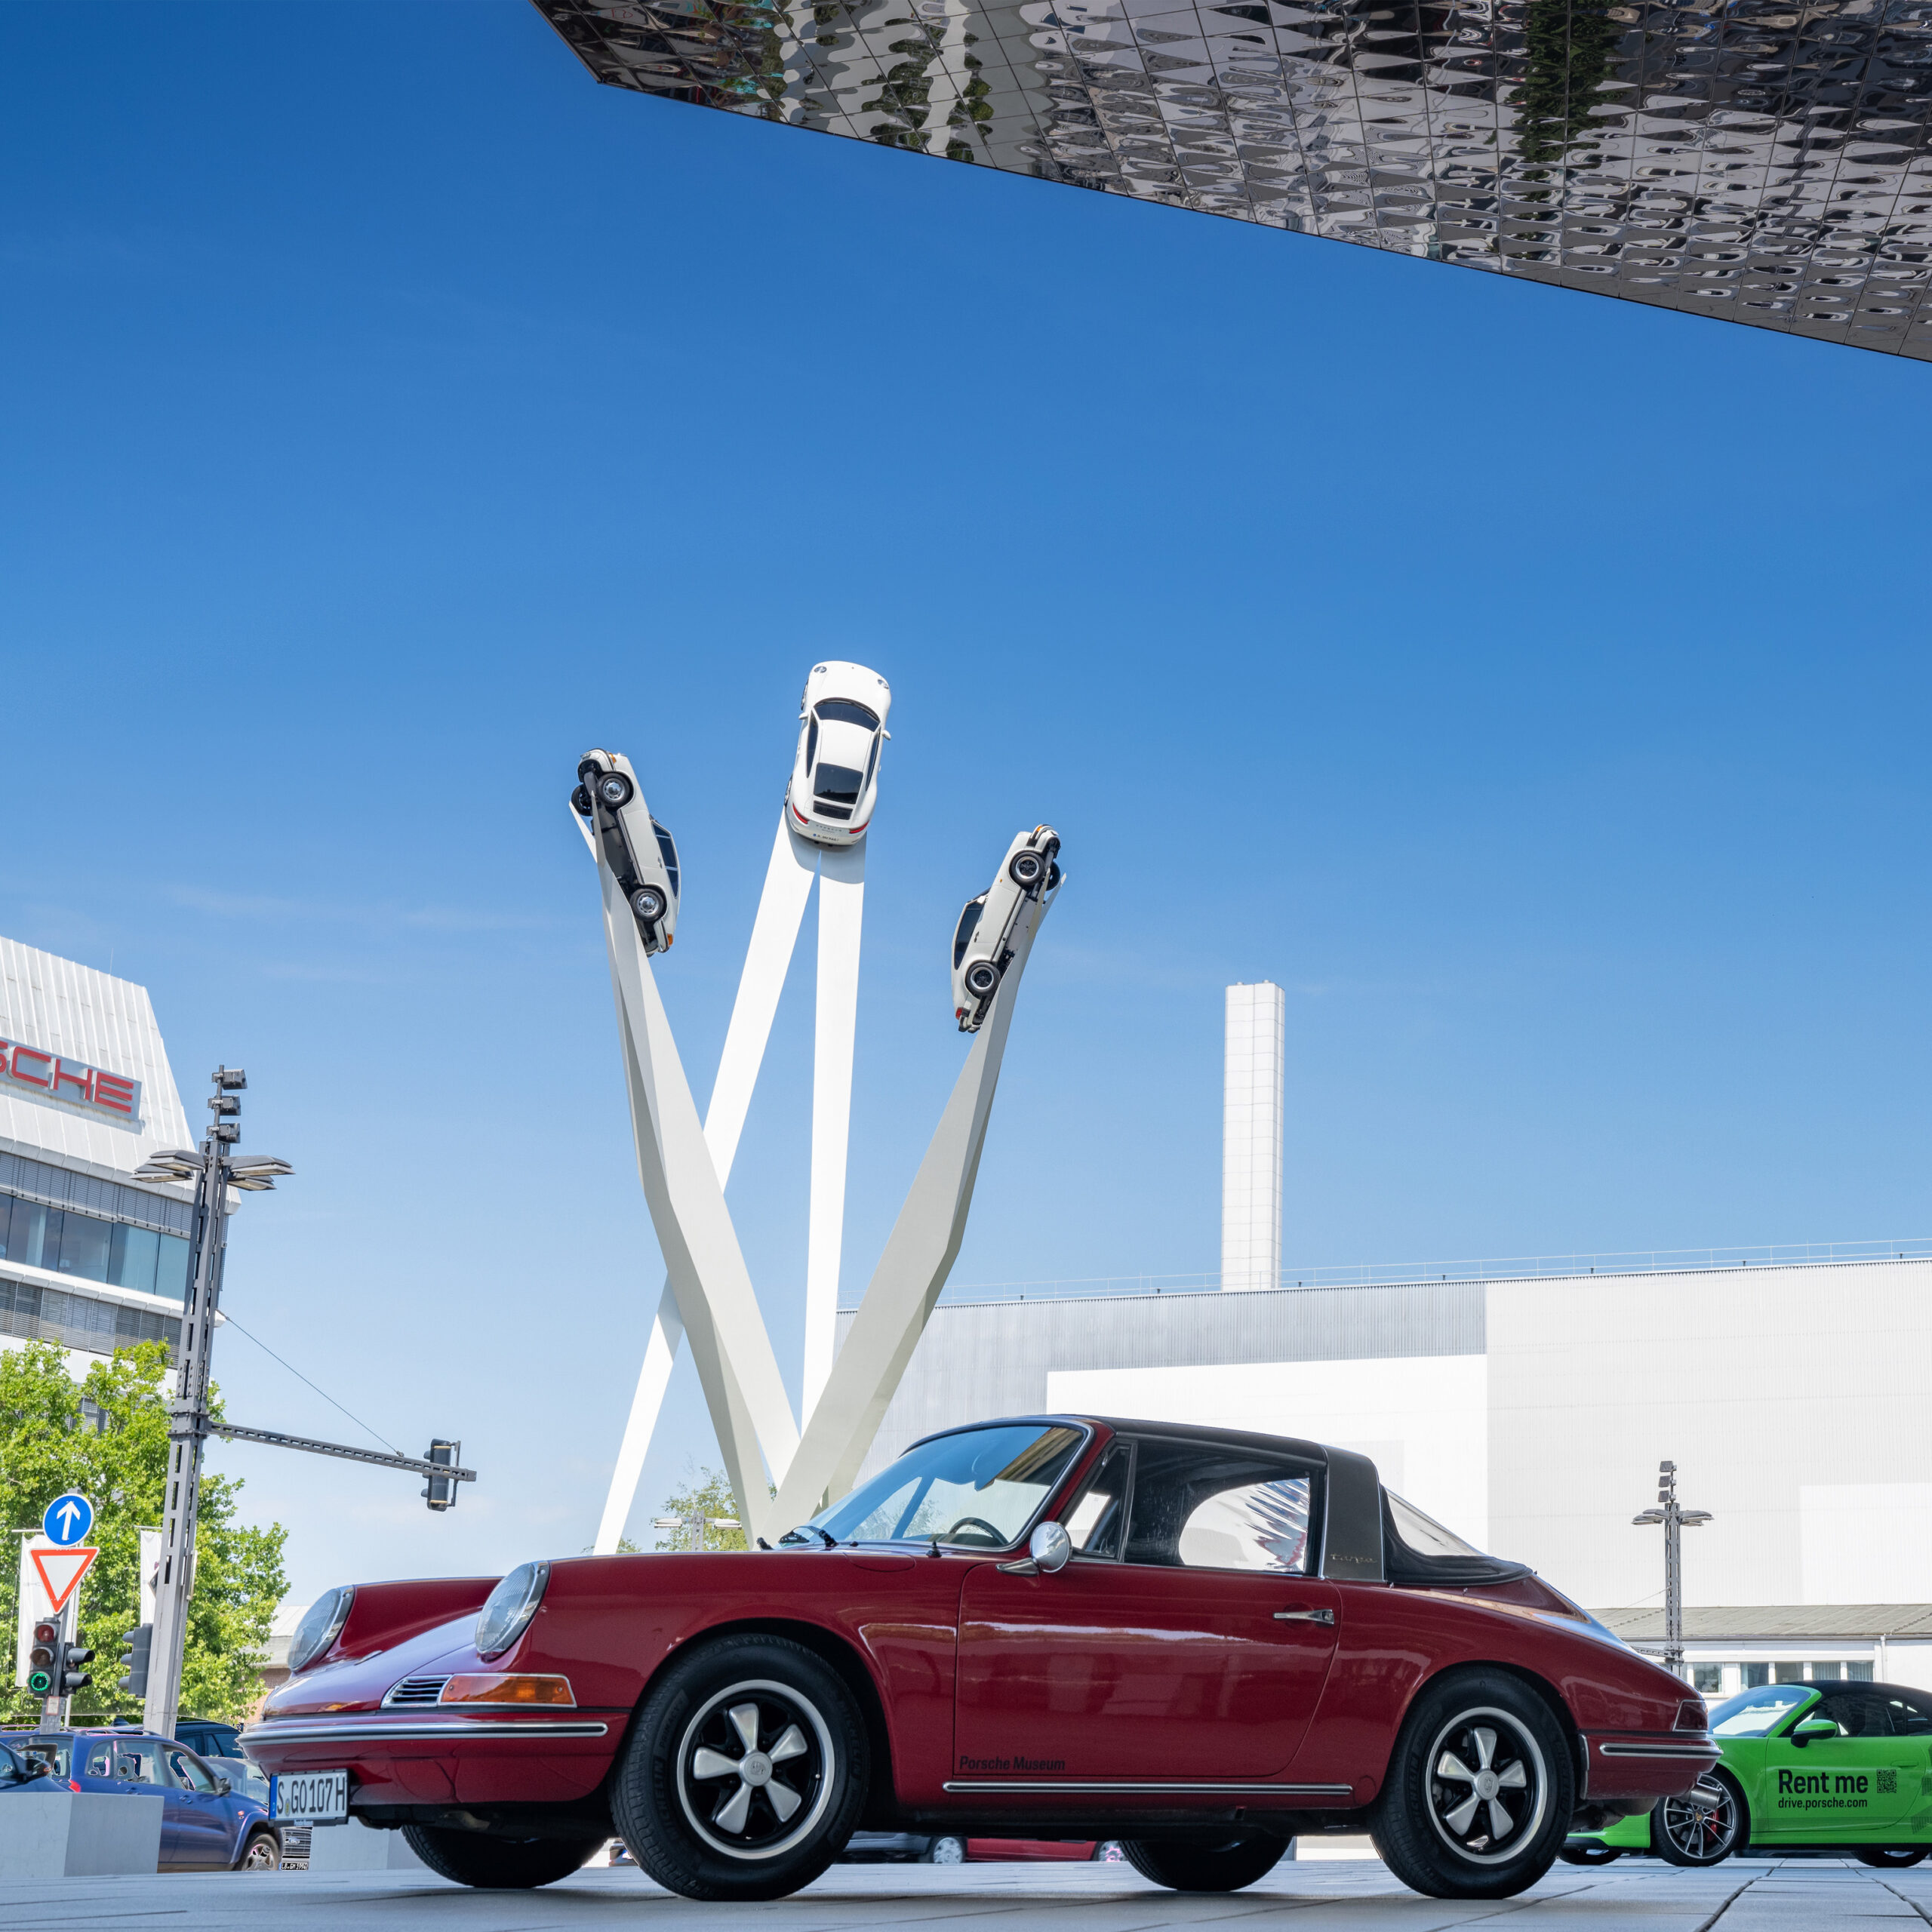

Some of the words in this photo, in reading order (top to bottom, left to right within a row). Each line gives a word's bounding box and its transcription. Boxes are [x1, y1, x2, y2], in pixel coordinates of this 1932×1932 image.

[0, 1039, 134, 1113] CHE
[959, 1755, 1010, 1770] Porsche
[1013, 1756, 1065, 1770] Museum
[1778, 1769, 1829, 1794] Rent
[1835, 1775, 1868, 1794] me
[1778, 1797, 1868, 1810] drive.porsche.com
